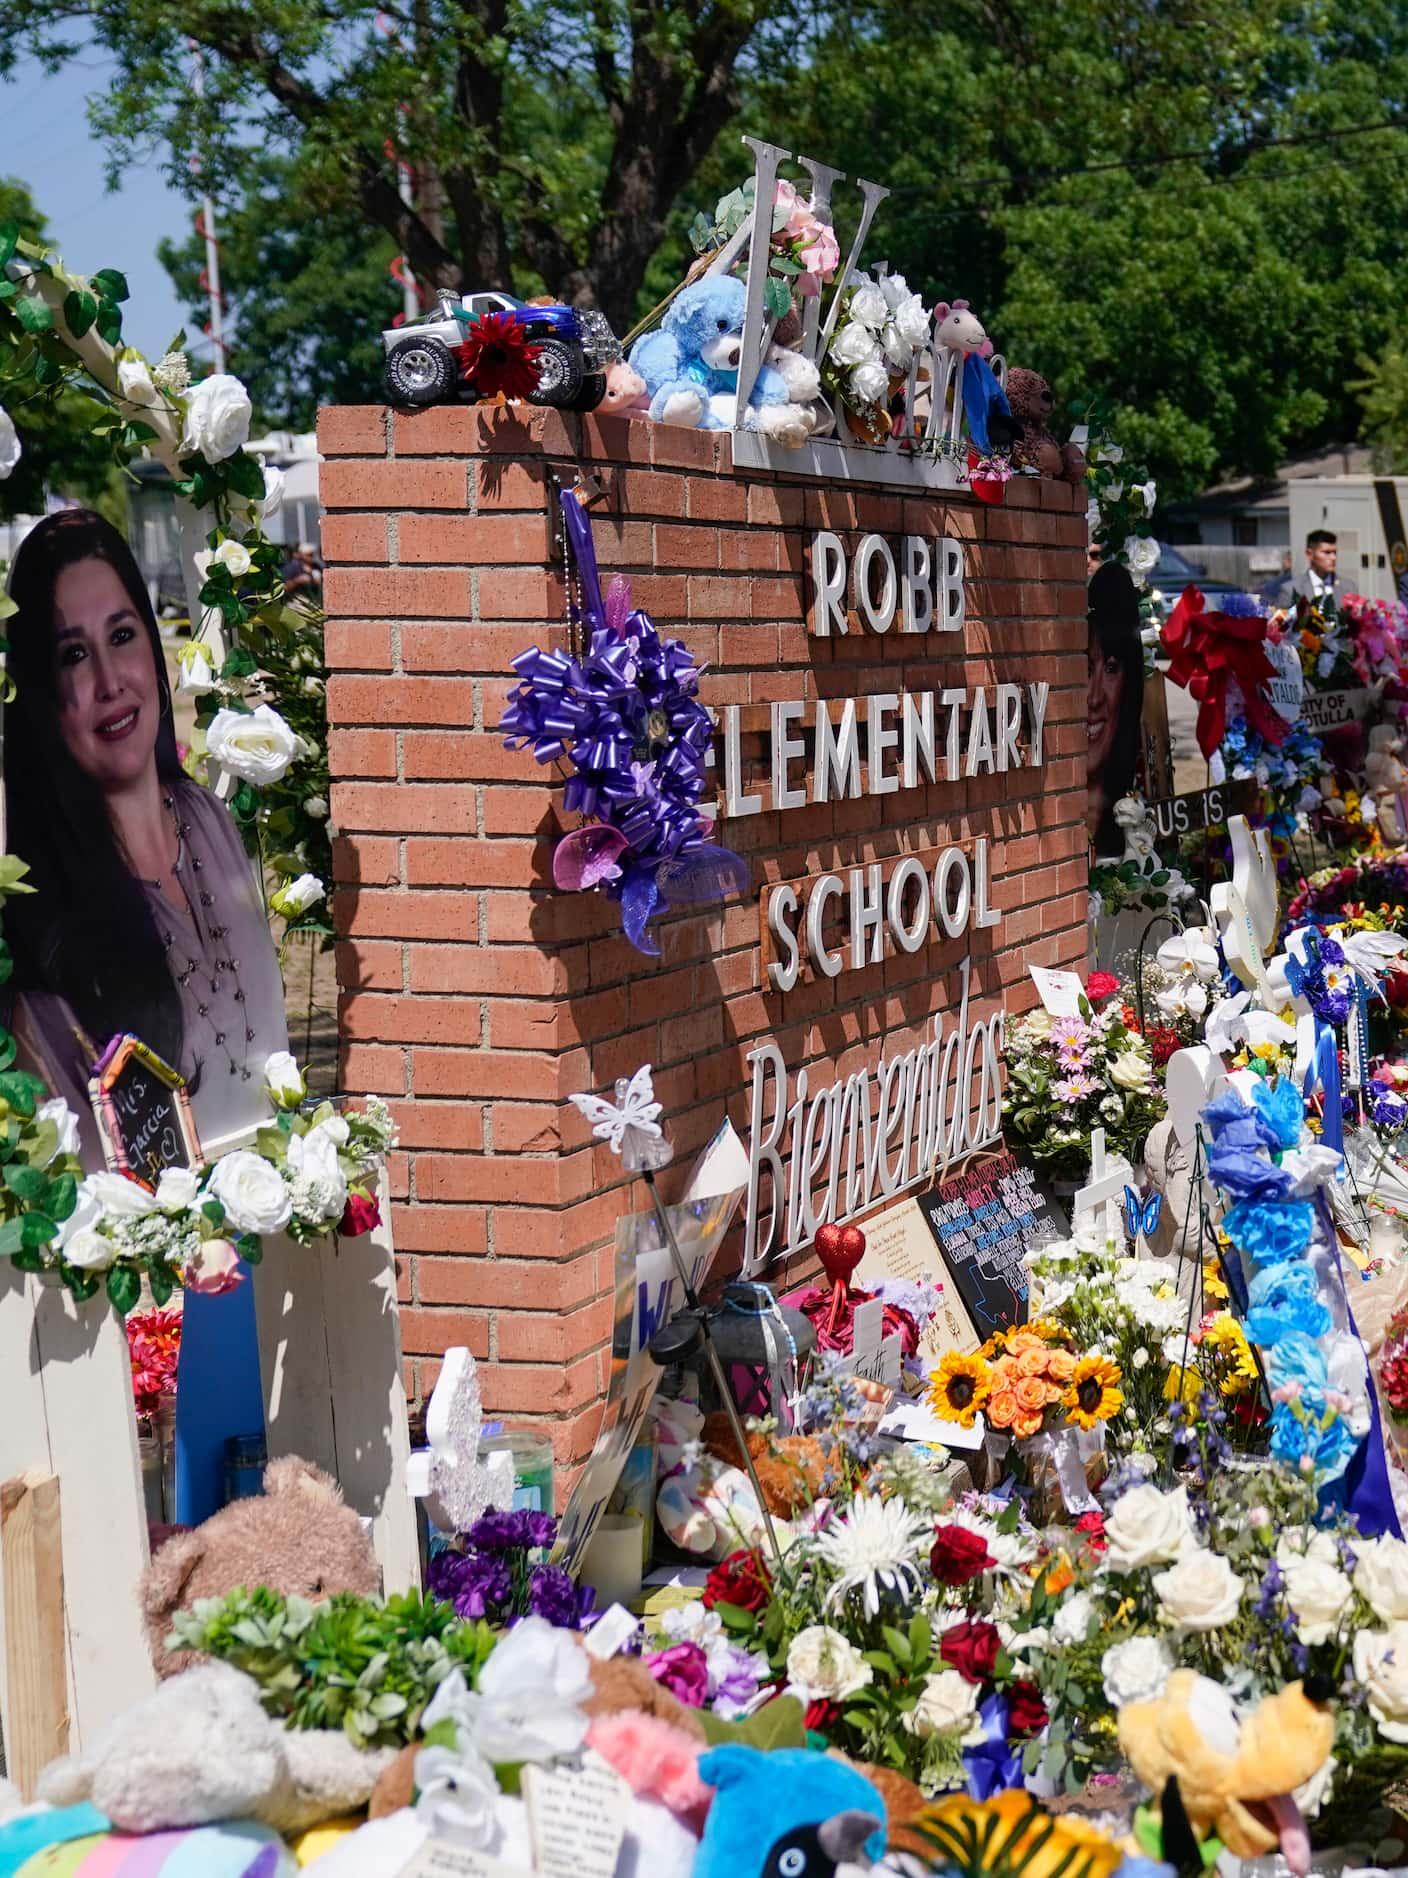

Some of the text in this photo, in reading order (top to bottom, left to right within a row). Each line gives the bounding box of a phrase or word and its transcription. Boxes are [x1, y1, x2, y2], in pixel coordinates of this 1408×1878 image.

[811, 531, 965, 637] ROBB
[694, 682, 1050, 817] LEMENTARY
[1327, 694, 1345, 709] OF
[1202, 789, 1224, 827] IS
[767, 837, 1002, 992] SCHOOL
[739, 955, 1006, 1281] Bienvenidos
[854, 1349, 886, 1384] Faith
